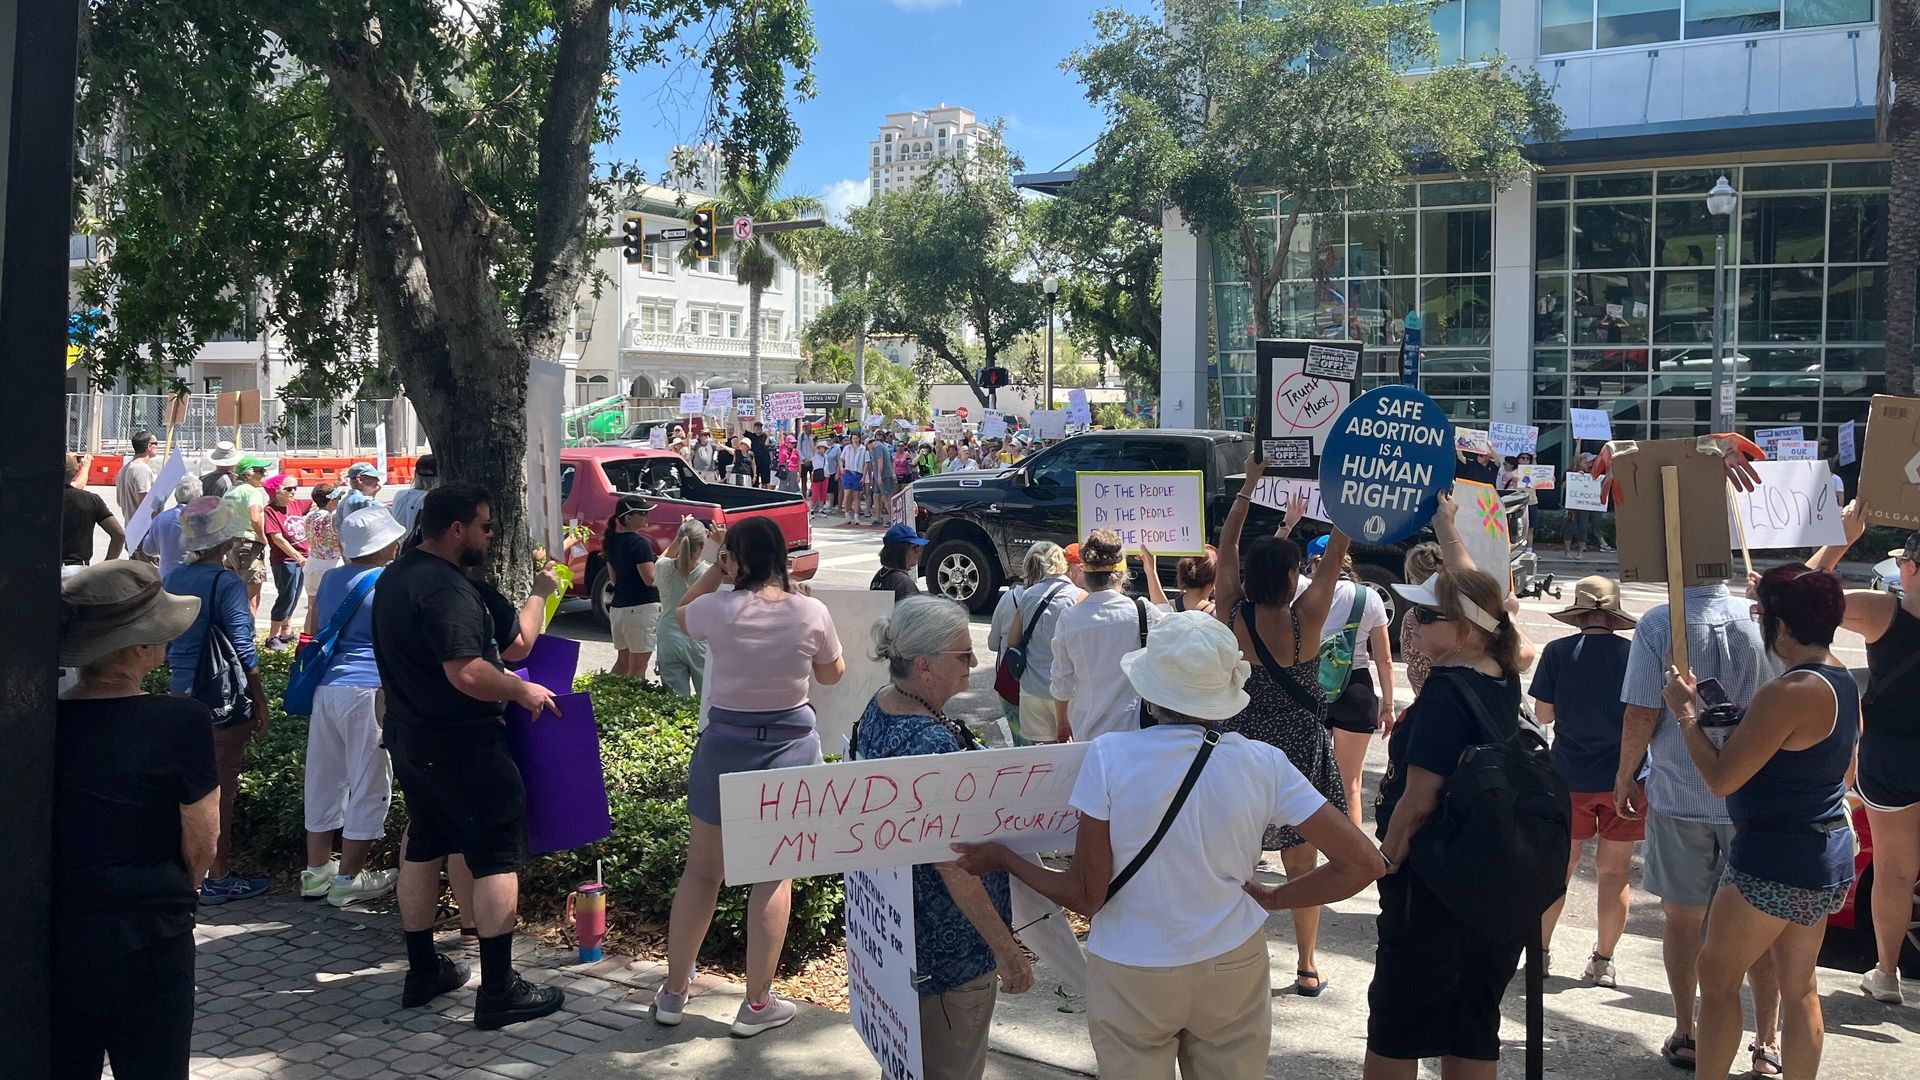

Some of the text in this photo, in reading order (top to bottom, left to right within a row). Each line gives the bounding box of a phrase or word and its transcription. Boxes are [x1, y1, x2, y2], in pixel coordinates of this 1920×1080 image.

[1320, 359, 1344, 370] OFF!
[1321, 353, 1344, 363] HANDS
[1281, 377, 1319, 407] TRUMP
[1376, 396, 1424, 421] SAFE
[1345, 416, 1444, 447] ABORTION
[1492, 423, 1530, 435] WE ELECT
[1379, 443, 1403, 458] IS A
[1505, 443, 1535, 452] KINGS
[1341, 454, 1433, 486] HUMAN
[1095, 483, 1174, 498] OF THE PEOPLE
[1253, 476, 1330, 519] RIGHT
[1340, 480, 1423, 513] RIGHT!
[1095, 507, 1174, 522] BY THE PEOPLE
[1141, 528, 1177, 544] PEOPLE
[759, 764, 1054, 822] HANDS OFF
[769, 831, 818, 866] MY
[849, 875, 903, 955] JUSTICE FOR
[889, 904, 901, 929] FOR
[848, 907, 884, 968] 60 YEARS
[860, 1006, 879, 1053] NO
[878, 1016, 891, 1041] can
[892, 1033, 908, 1063] walk
